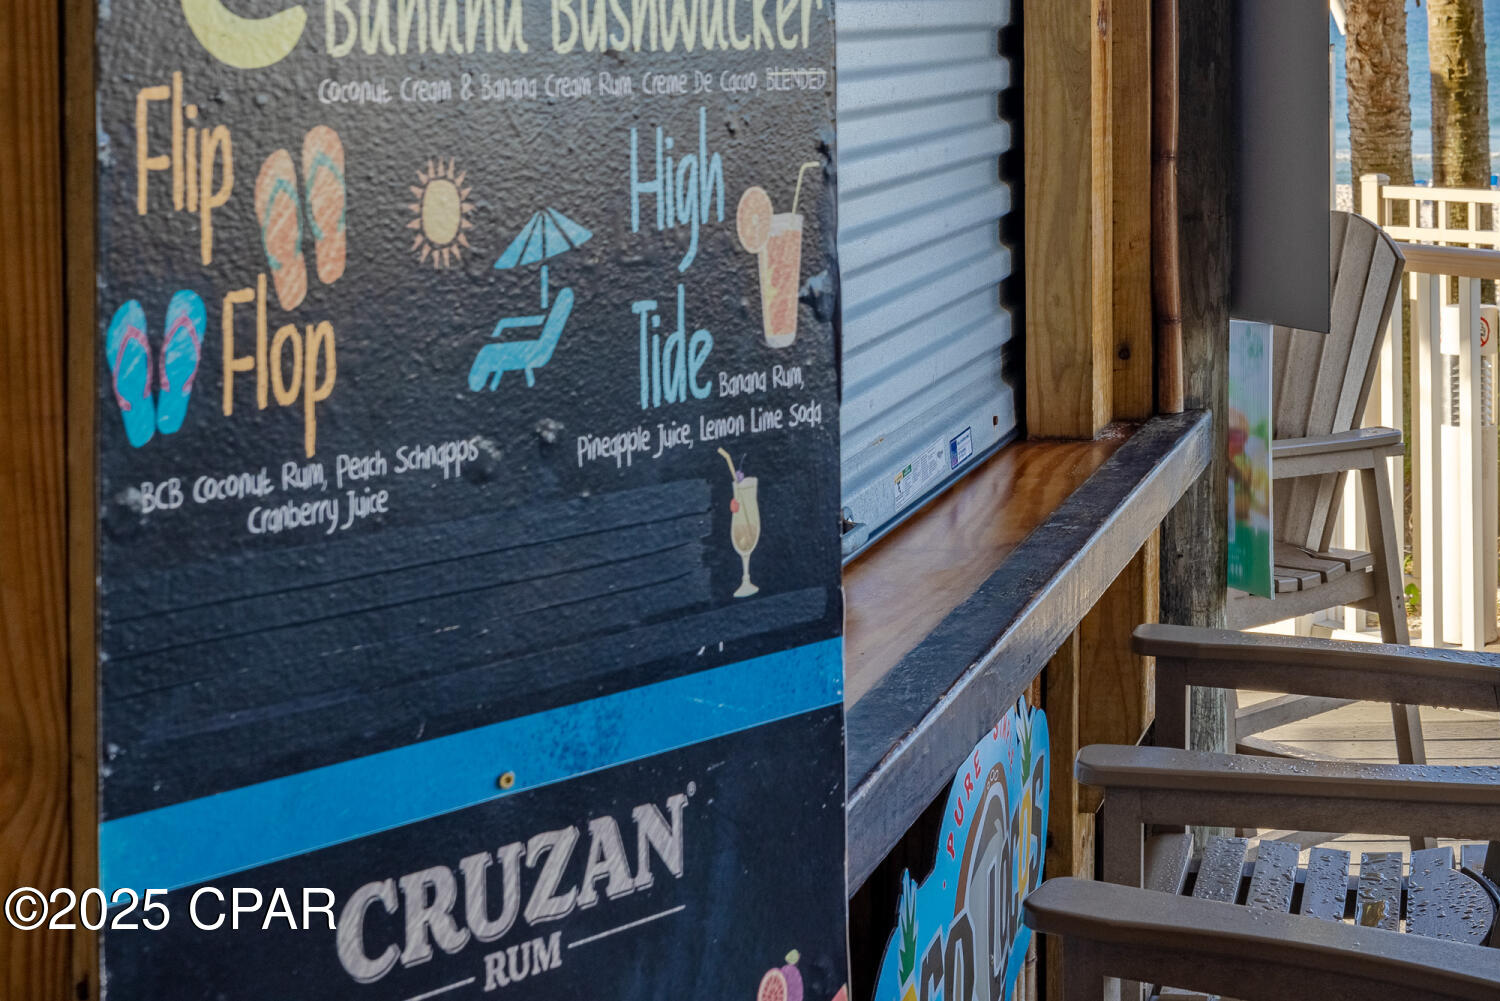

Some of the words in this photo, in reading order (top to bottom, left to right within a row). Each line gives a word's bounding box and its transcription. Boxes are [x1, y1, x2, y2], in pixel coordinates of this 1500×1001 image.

[318, 78, 392, 105] Coconut
[400, 76, 451, 101] Cream
[460, 72, 475, 100] &
[480, 73, 537, 100] Banana
[544, 73, 592, 99] Cream
[641, 71, 688, 96] Creme
[694, 69, 713, 94] De
[136, 70, 234, 266] Flip
[630, 106, 726, 272] High
[221, 272, 337, 459] Flop
[631, 282, 714, 410] Tide
[718, 371, 767, 398] Banana
[772, 364, 804, 390] Rum,
[577, 425, 651, 469] Pineapple
[652, 420, 694, 459] Juice,
[699, 413, 745, 442] Lemon
[750, 406, 783, 433] Lime
[788, 399, 822, 428] Soda
[140, 477, 184, 513] BCB
[193, 467, 275, 504] Coconut
[281, 460, 327, 491] Rum,
[336, 450, 387, 488] Peach
[394, 435, 482, 480] Schnapps
[247, 497, 339, 535] Cranberry
[340, 486, 389, 530] Juice
[947, 750, 981, 859] PURE
[482, 930, 563, 993] RUM
